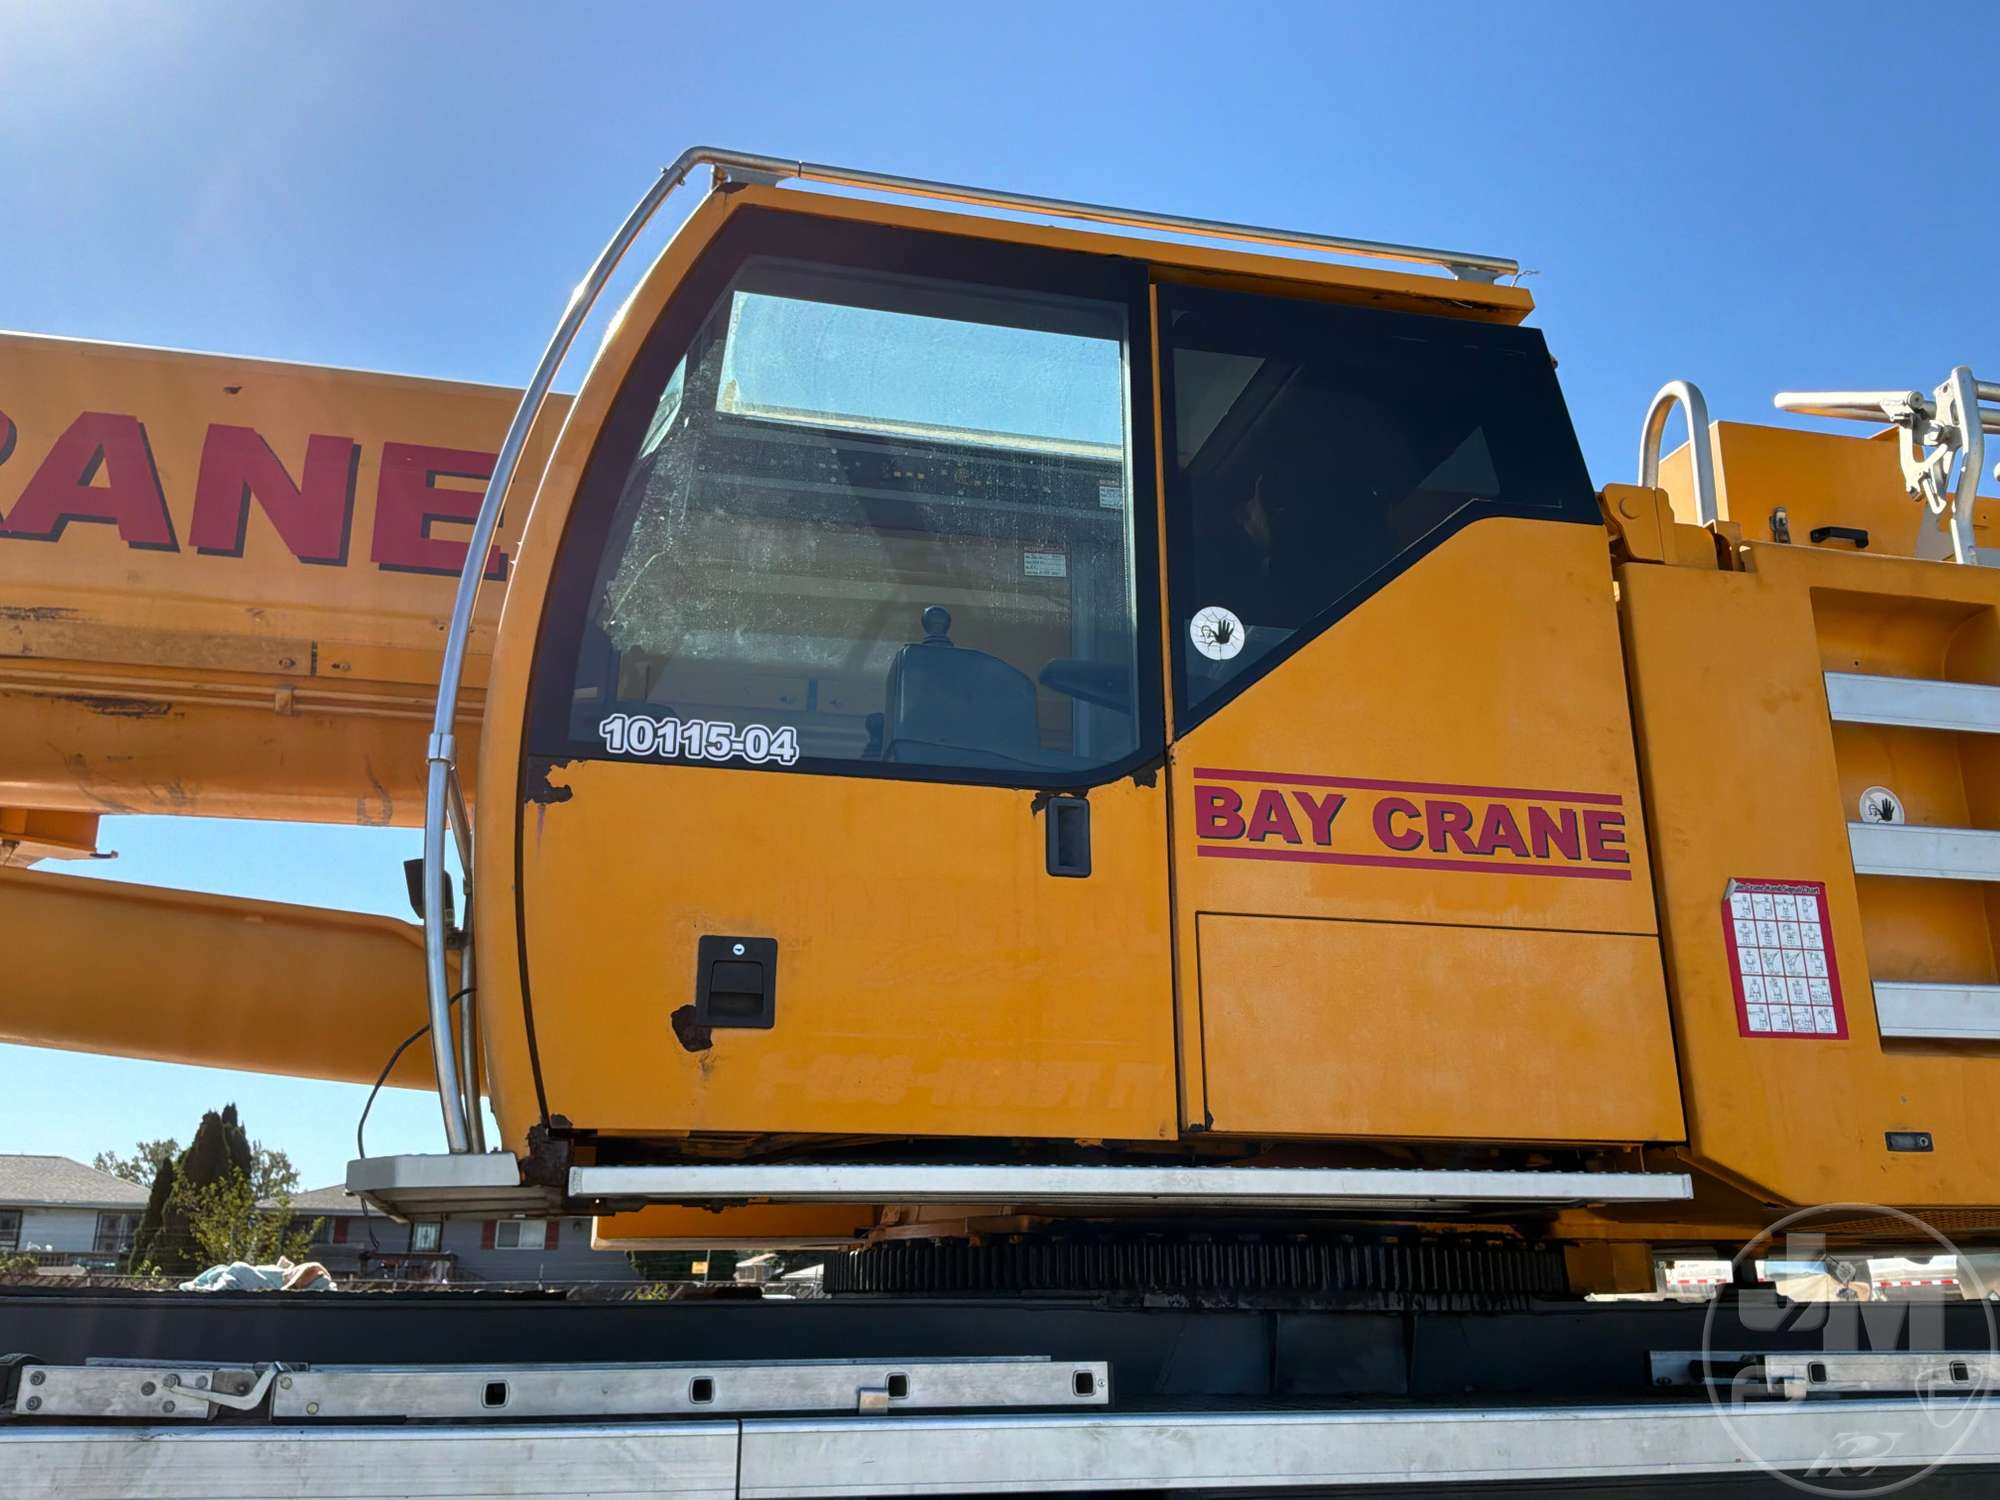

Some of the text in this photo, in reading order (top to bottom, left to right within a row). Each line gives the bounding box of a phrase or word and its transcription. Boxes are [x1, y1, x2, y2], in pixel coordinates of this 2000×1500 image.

[0, 411, 508, 581] ANE
[599, 713, 799, 766] 10115-04
[1193, 785, 1630, 863] BAY CRANE
